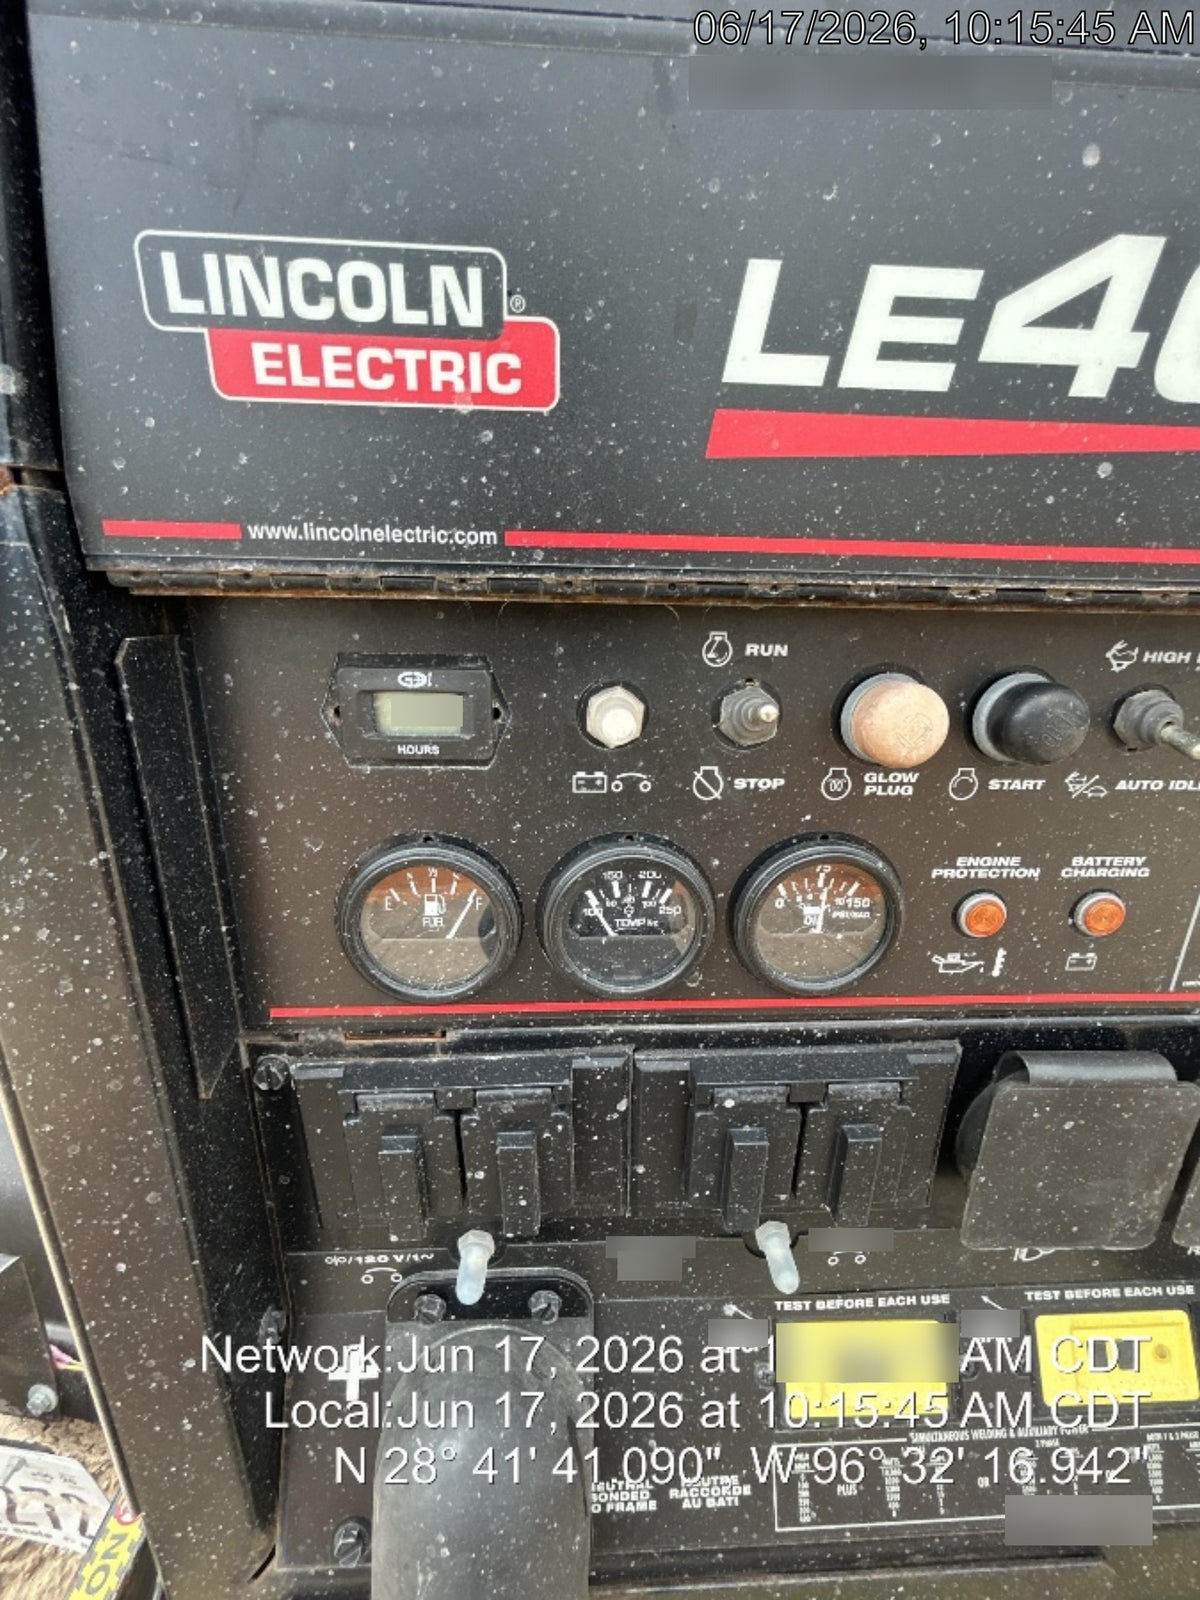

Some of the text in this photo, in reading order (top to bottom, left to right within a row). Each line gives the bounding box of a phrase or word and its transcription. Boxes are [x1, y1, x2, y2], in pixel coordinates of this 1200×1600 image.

[160, 251, 483, 327] LINCOLN
[250, 341, 522, 395] ELECTRIC
[247, 522, 498, 546] www.lincolnelectric.com
[745, 643, 789, 657] RUN
[1142, 651, 1192, 664] HIGH
[397, 744, 440, 755] HOURS
[733, 777, 785, 790] STOP
[863, 772, 920, 784] GLOW
[863, 785, 914, 796] PLUG
[988, 779, 1047, 790] START
[1114, 780, 1200, 791] AUTO IDL
[956, 856, 1022, 867] ENGINE
[1071, 856, 1147, 867] BATTERY
[931, 868, 1041, 879] PROTECTION
[1060, 867, 1151, 878] CHARGING
[384, 896, 393, 911] E
[1024, 1285, 1196, 1301] TEST BEFORE EACH USE
[774, 1294, 951, 1311] TEST BEFORE EACH USE
[909, 1429, 970, 1444] SIMULTANEOUS
[971, 1428, 1008, 1441] WELDING
[1017, 1425, 1059, 1439] AUXILIARY
[837, 1484, 858, 1496] PLUS
[605, 1499, 657, 1513] FRAME
[682, 1498, 702, 1509] AU
